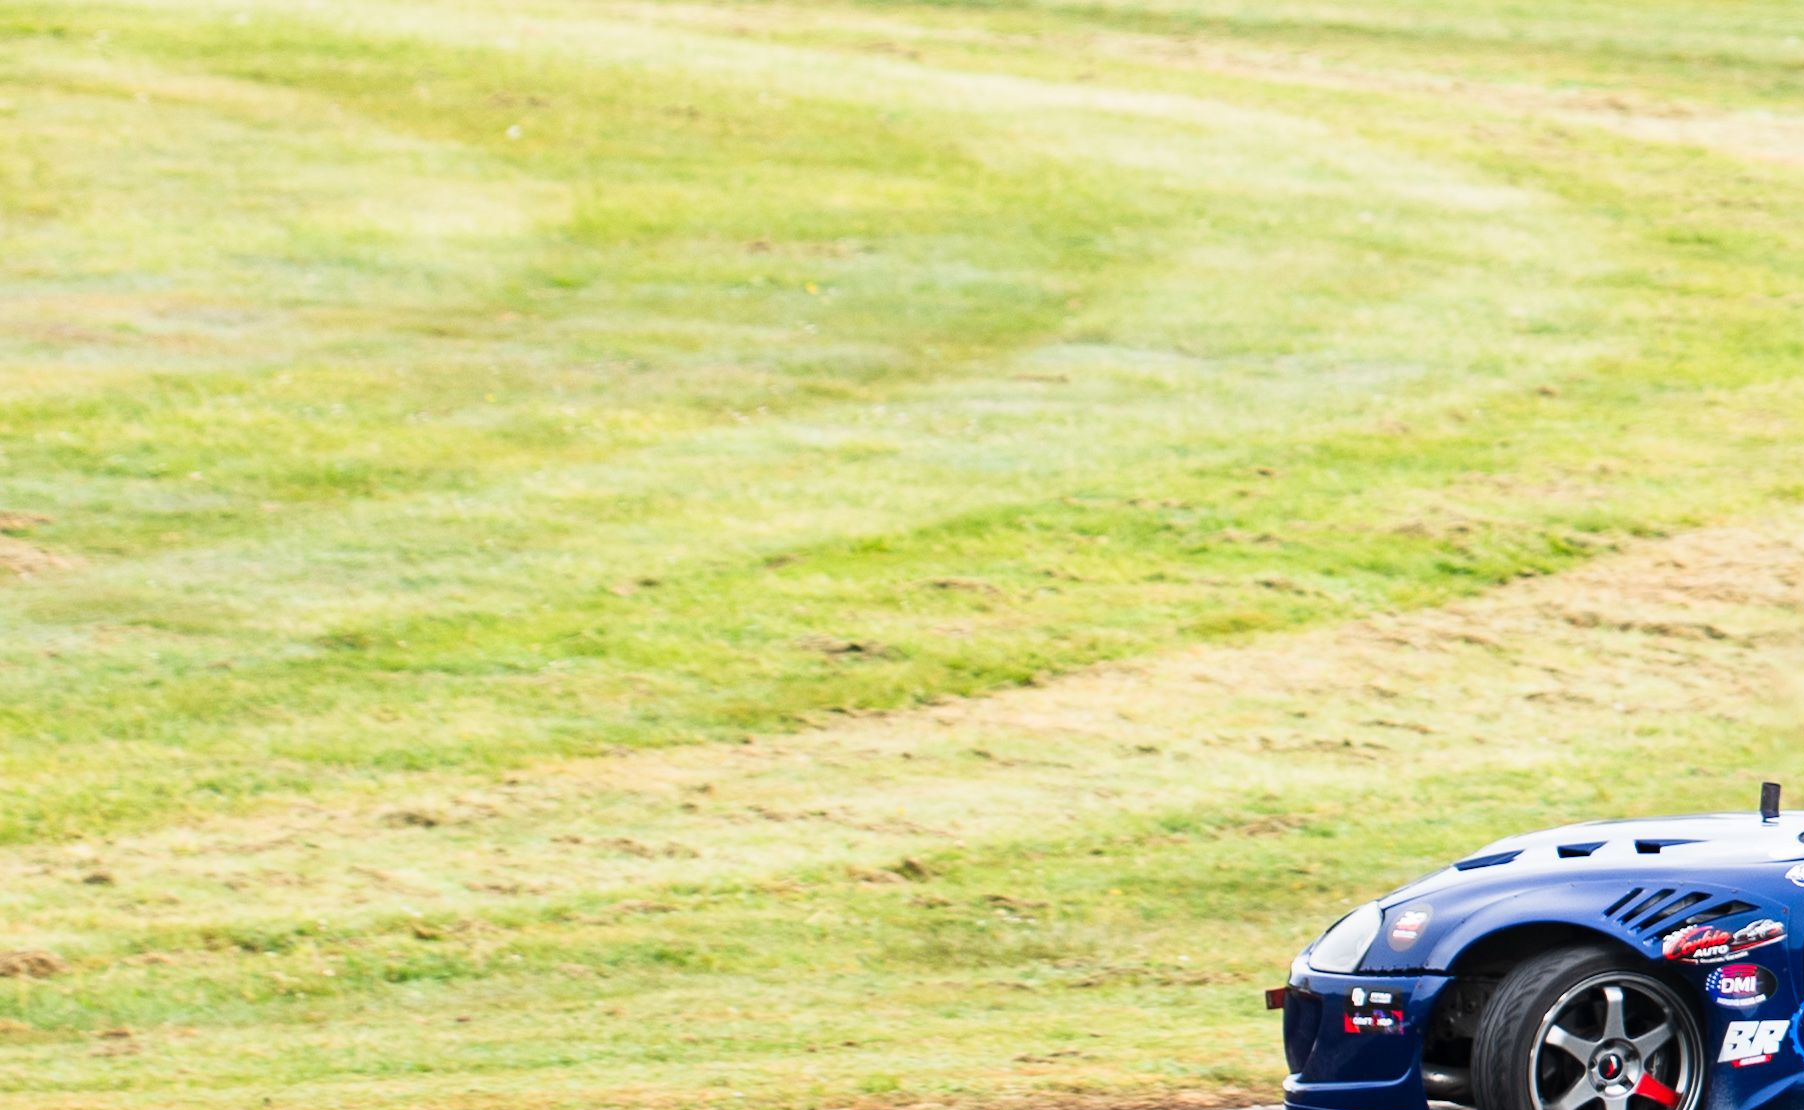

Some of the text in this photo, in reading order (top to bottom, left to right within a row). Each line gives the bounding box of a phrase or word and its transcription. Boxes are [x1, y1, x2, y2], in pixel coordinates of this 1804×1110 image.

[1693, 944, 1729, 958] AUTO
[1721, 975, 1757, 993] DMI
[1717, 1020, 1791, 1063] BR
